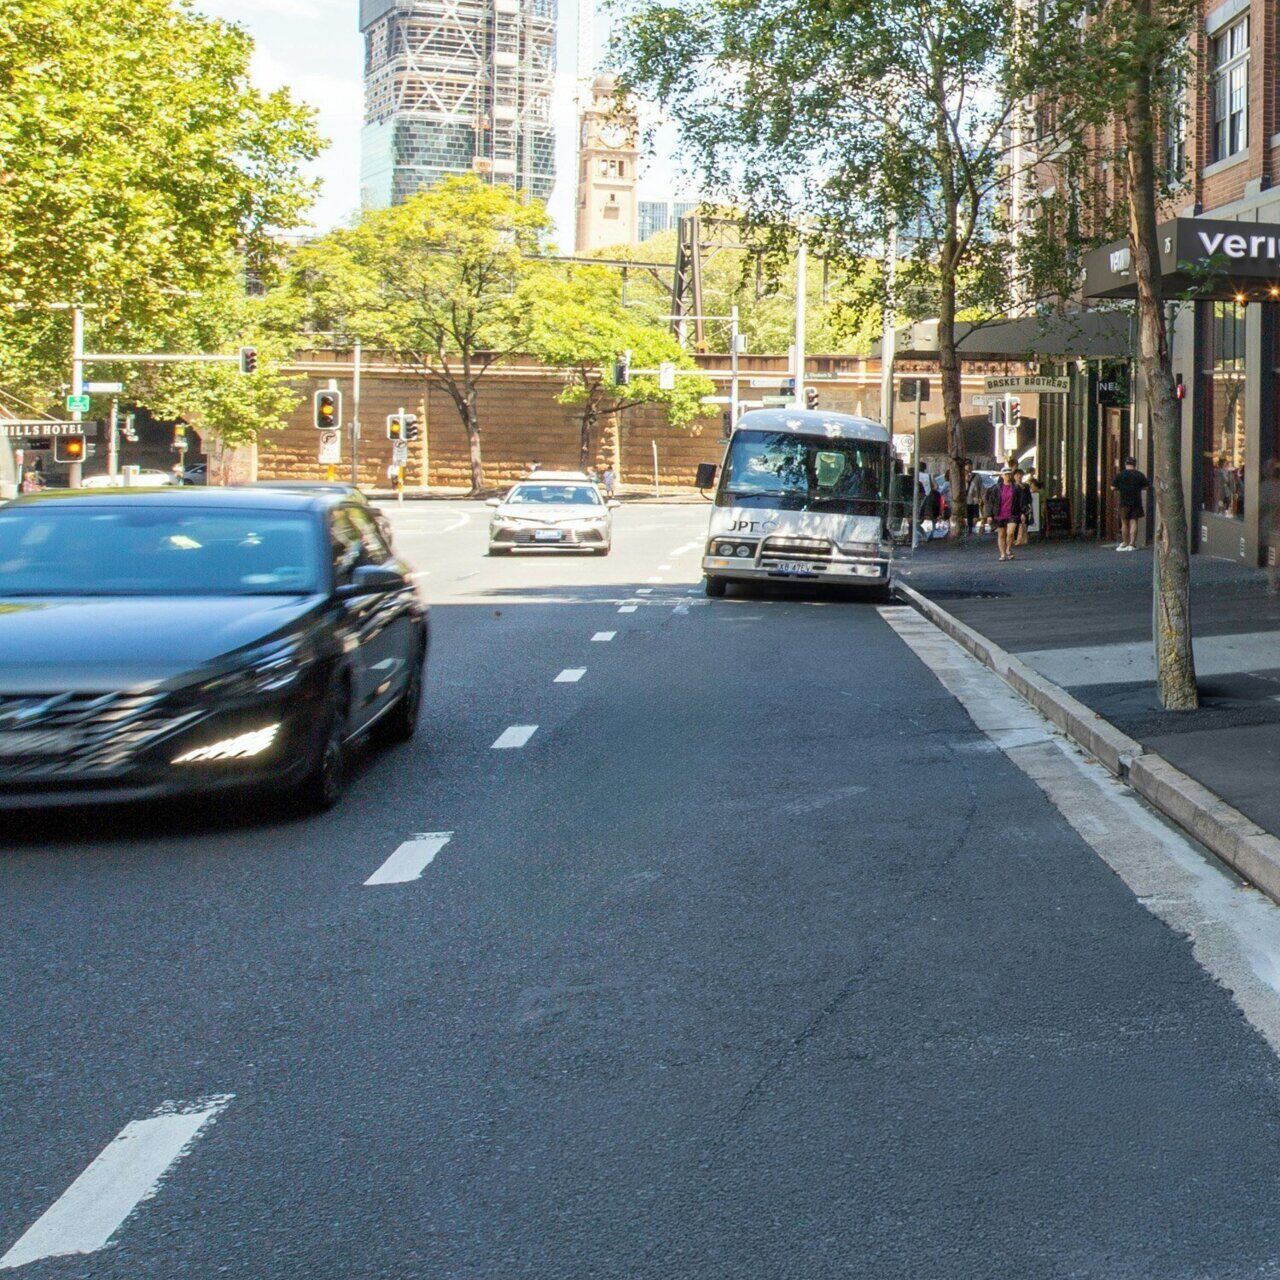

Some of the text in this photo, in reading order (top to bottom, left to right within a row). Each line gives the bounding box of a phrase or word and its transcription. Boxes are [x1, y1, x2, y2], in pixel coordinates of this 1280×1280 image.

[987, 377, 1069, 389] BASKET BROTHERS
[43, 424, 84, 435] HOTEL
[728, 520, 760, 532] JPT
